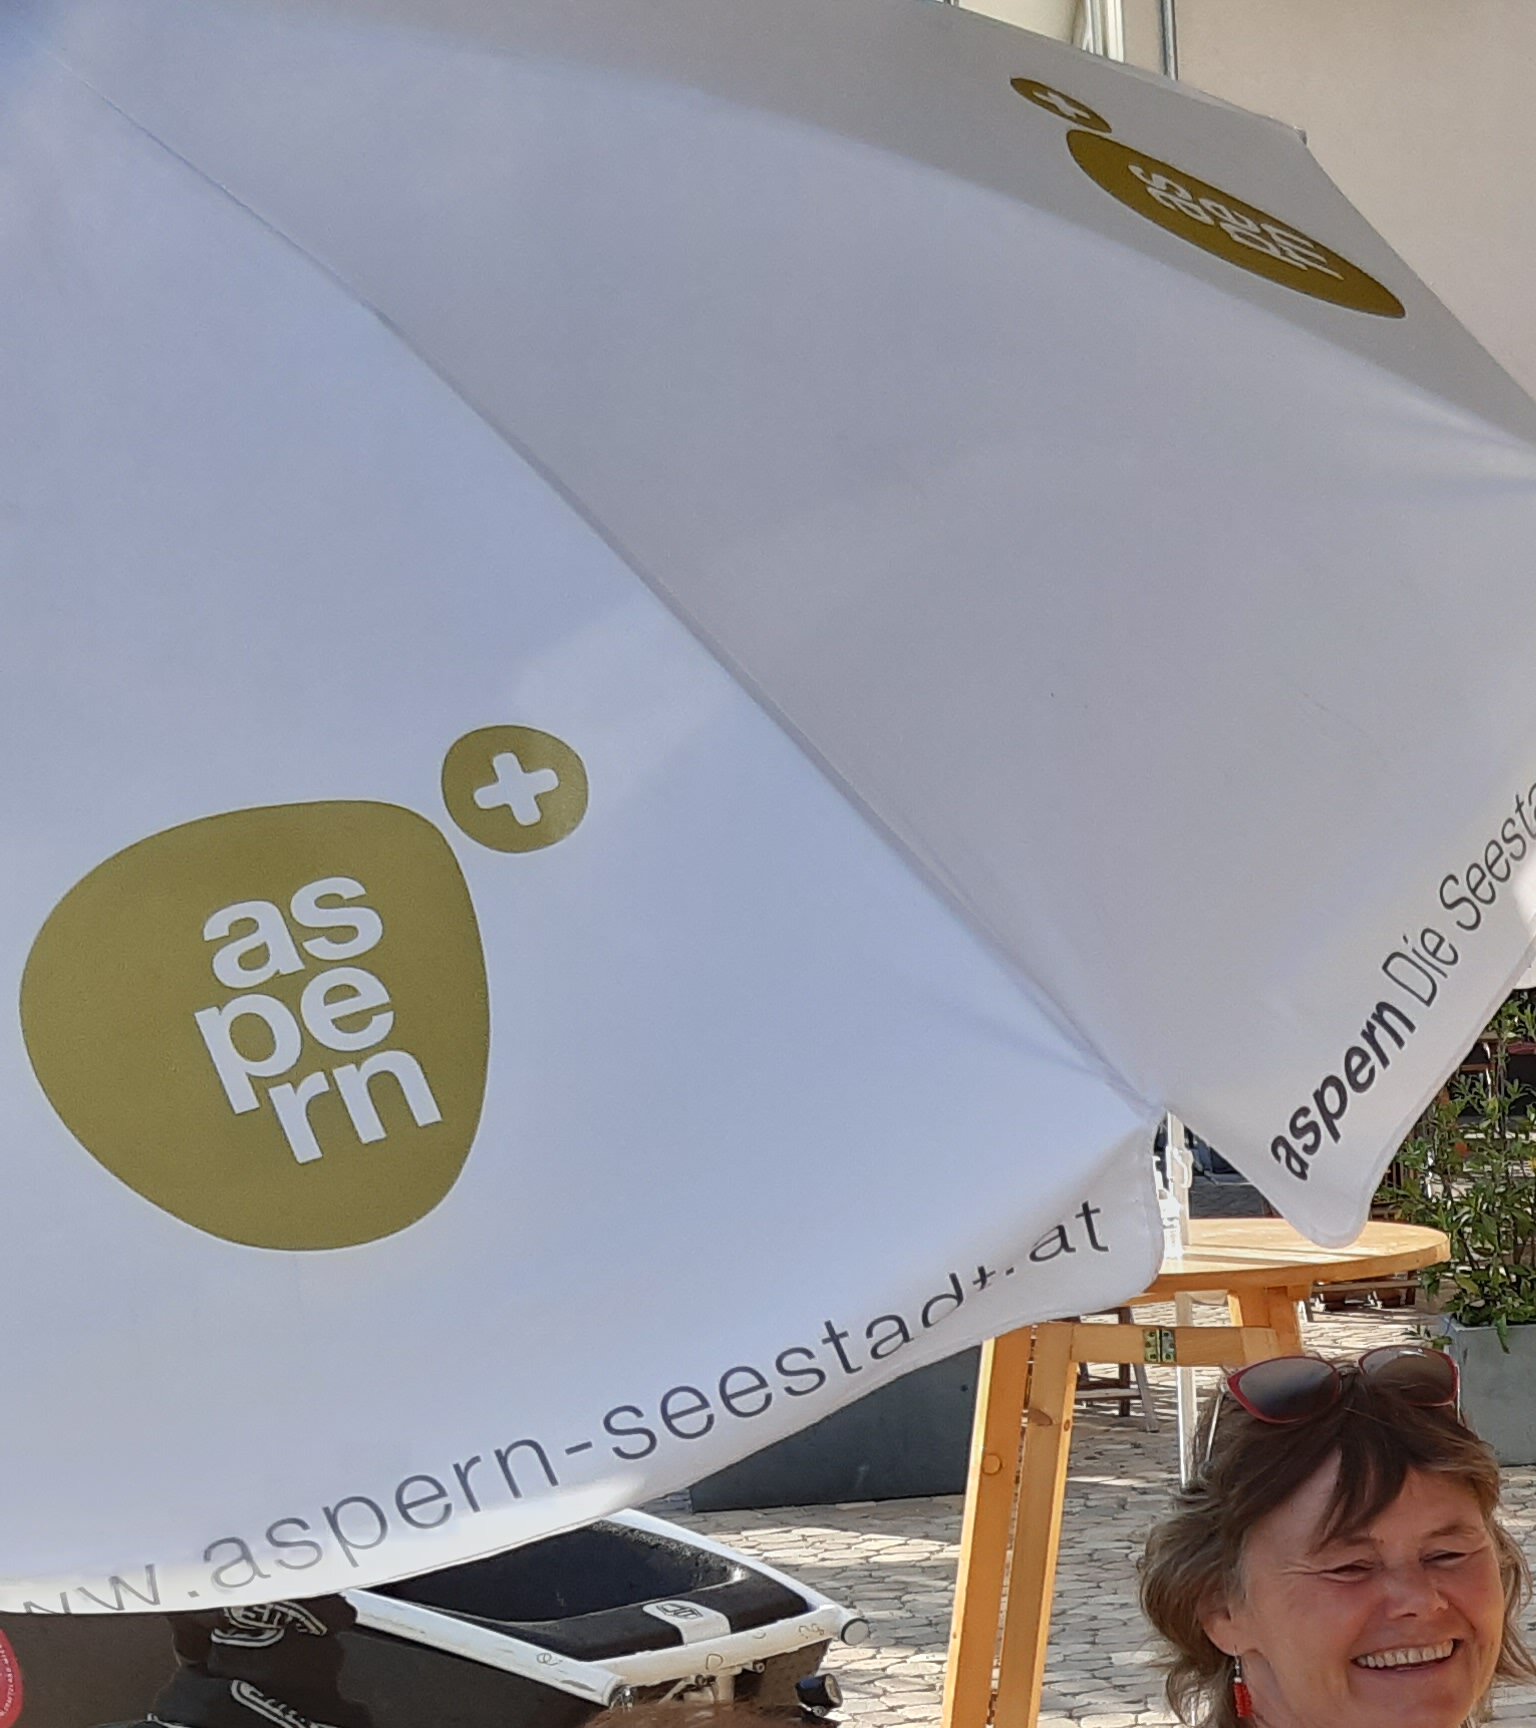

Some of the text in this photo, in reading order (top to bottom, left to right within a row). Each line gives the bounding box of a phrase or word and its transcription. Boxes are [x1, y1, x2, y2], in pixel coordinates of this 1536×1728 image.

[201, 874, 385, 989] as
[194, 965, 395, 1116] pe
[265, 1048, 445, 1165] rn
[1271, 998, 1418, 1181] aspern
[1381, 920, 1459, 1008] Die
